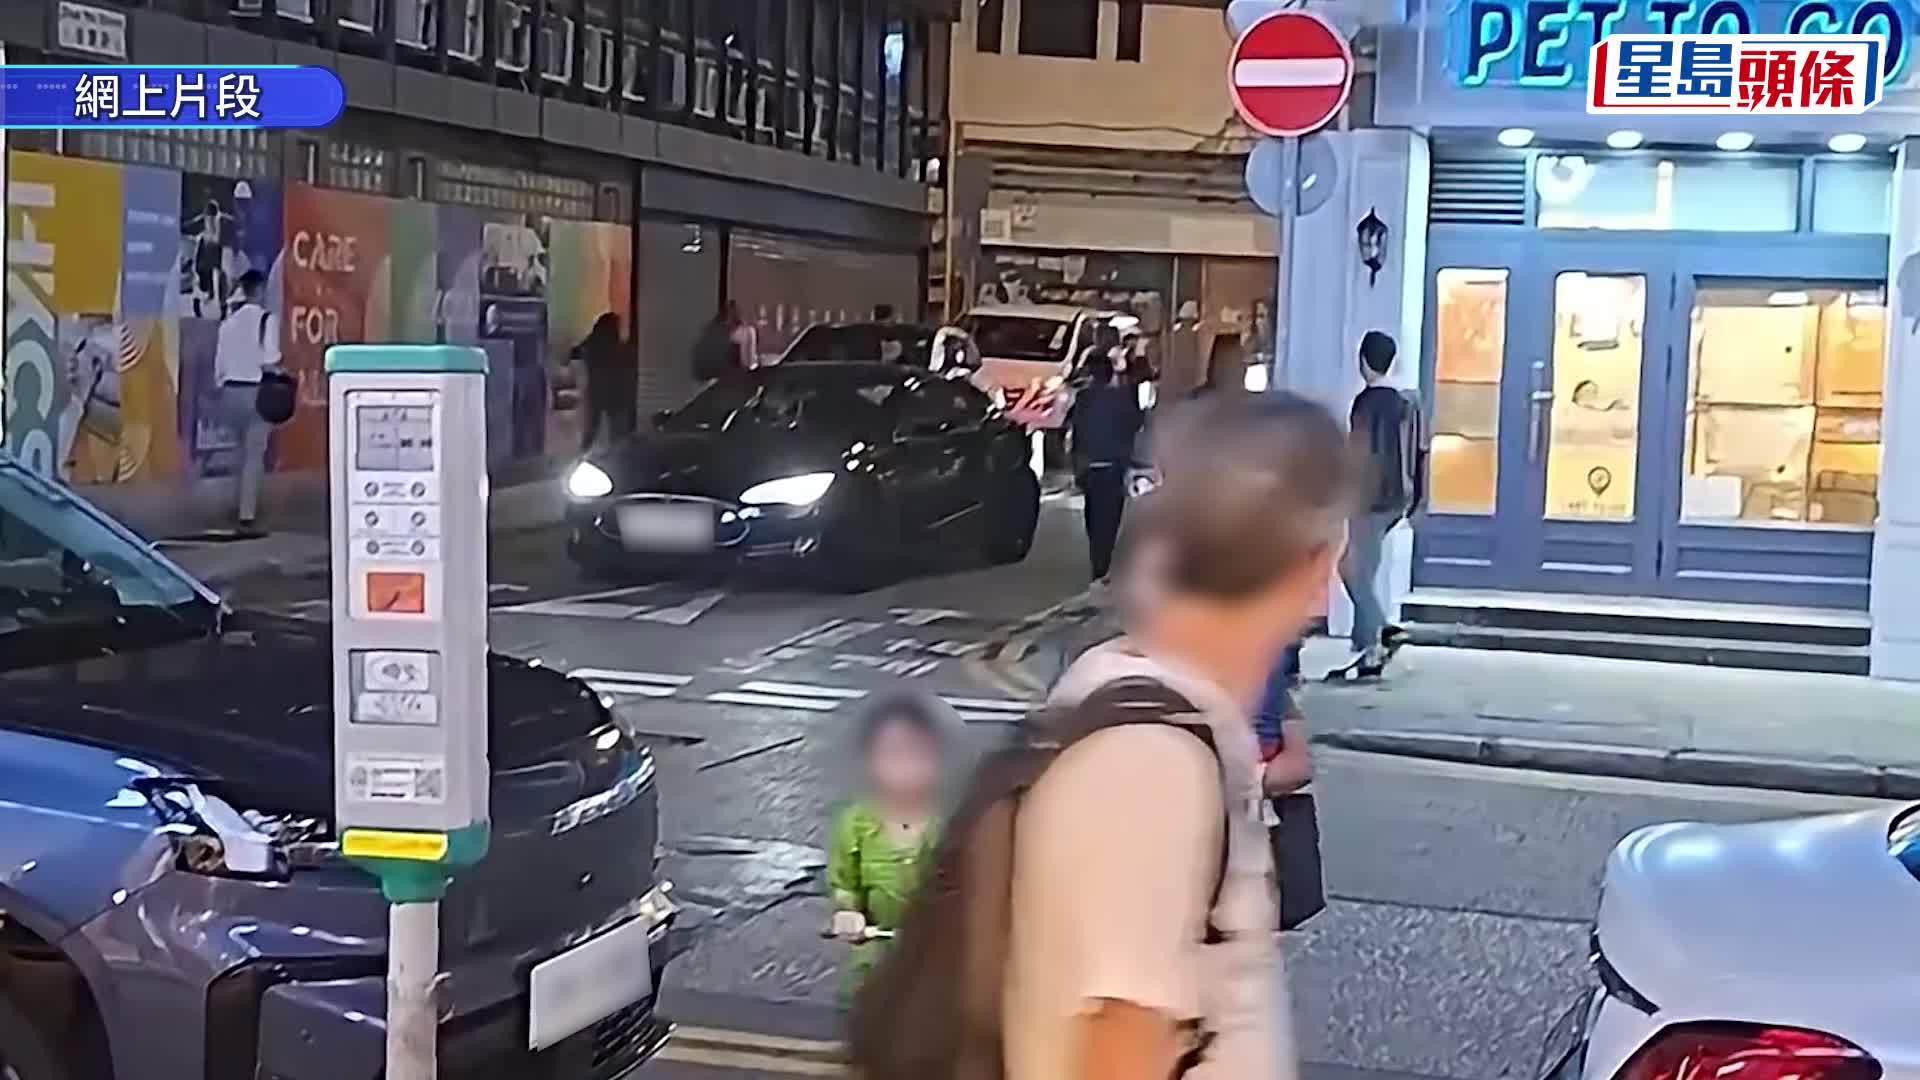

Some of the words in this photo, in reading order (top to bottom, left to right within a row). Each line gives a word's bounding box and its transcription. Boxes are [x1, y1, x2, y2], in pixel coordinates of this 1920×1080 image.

[1464, 0, 1627, 86] PET
[293, 231, 357, 272] CARE
[291, 306, 339, 344] FOR
